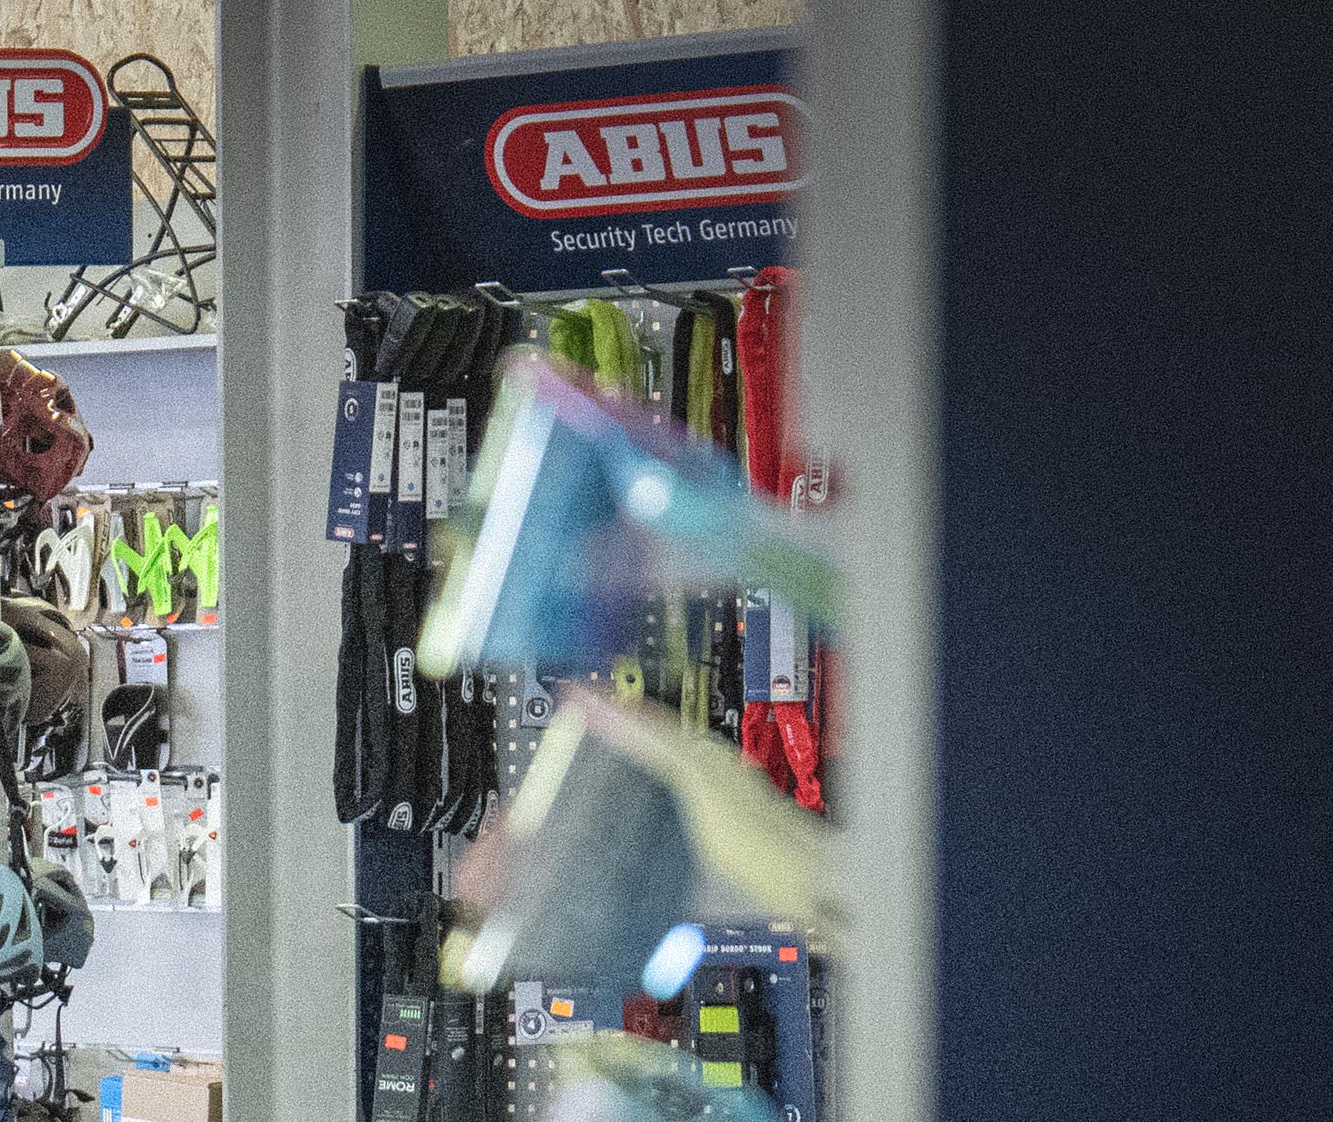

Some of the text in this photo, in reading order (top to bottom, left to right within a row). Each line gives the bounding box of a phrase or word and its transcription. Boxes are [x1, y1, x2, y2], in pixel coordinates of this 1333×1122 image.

[539, 112, 787, 190] ABUS
[550, 216, 800, 252] Security Tech Germany
[399, 656, 414, 704] ABUS
[378, 1079, 415, 1093] ROME
